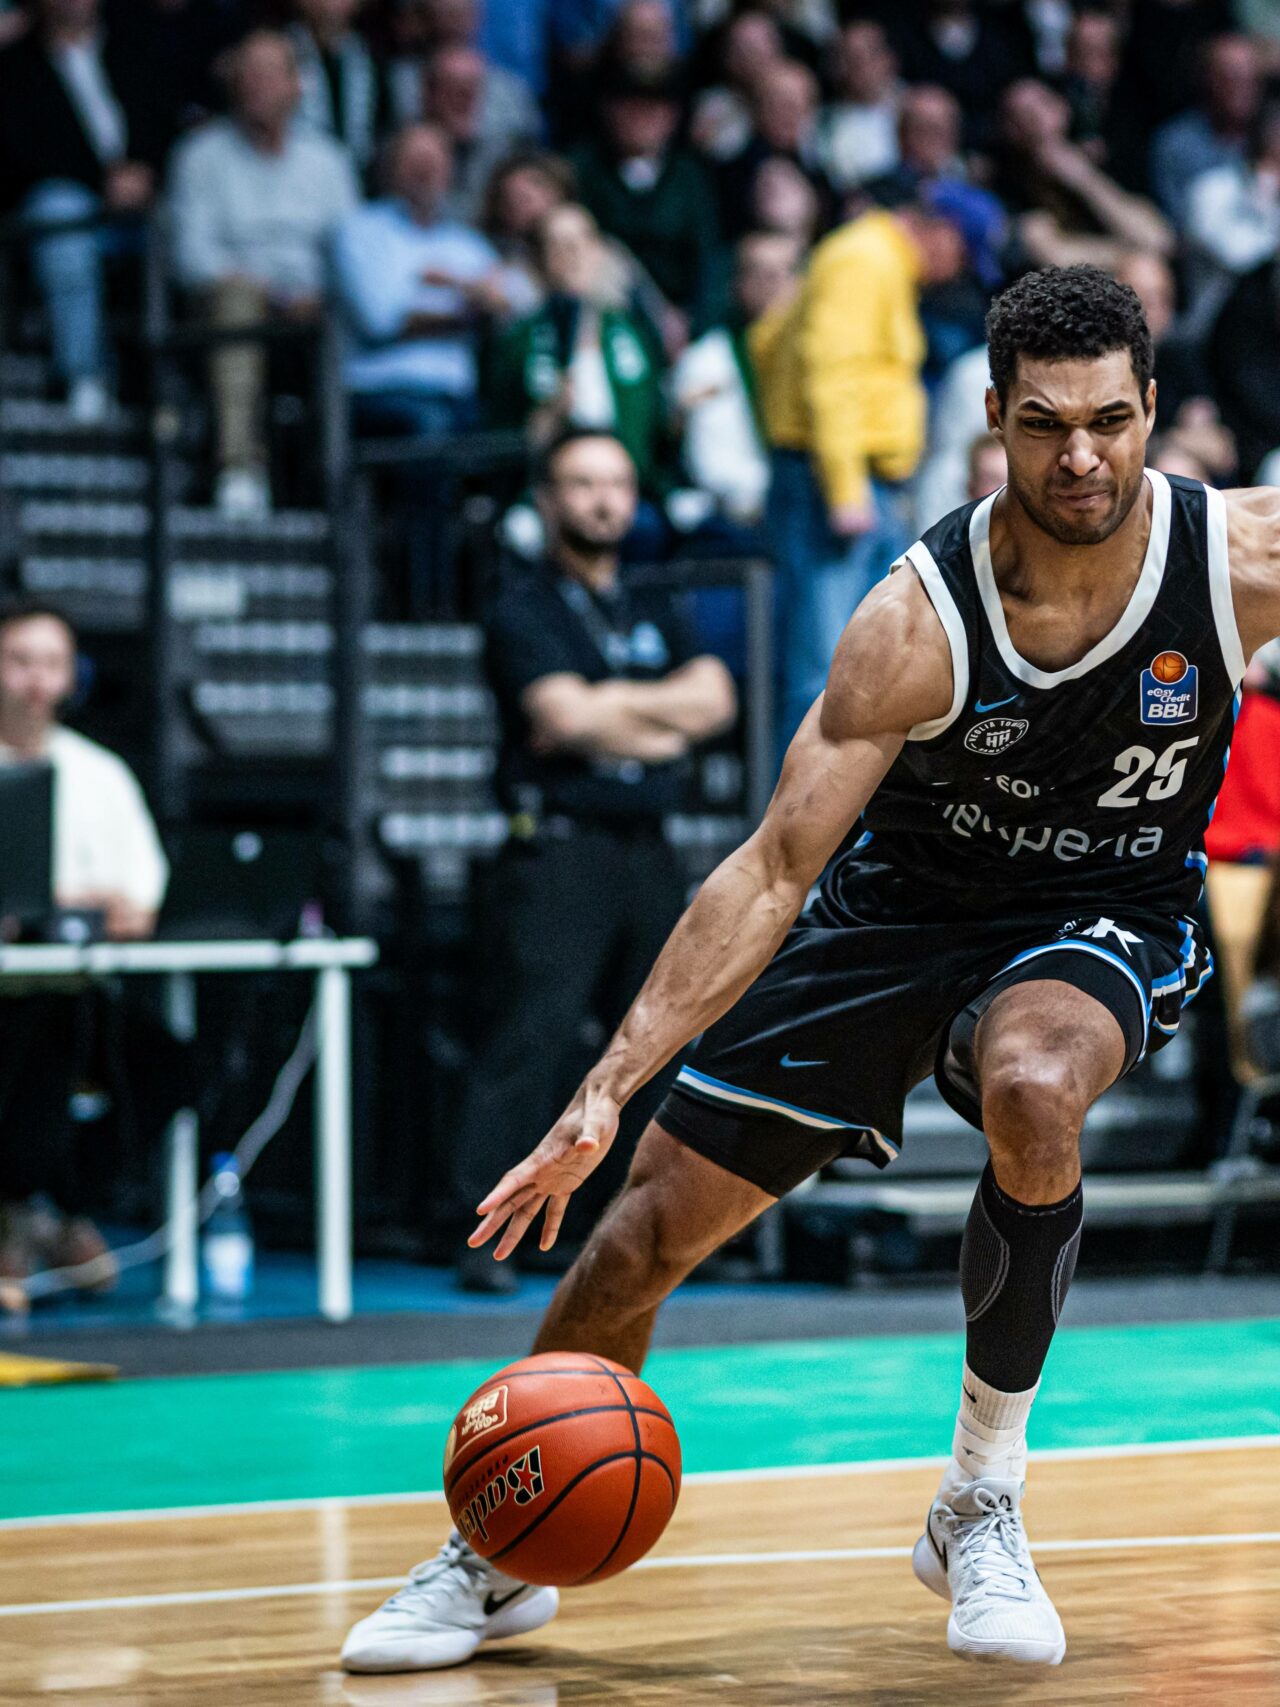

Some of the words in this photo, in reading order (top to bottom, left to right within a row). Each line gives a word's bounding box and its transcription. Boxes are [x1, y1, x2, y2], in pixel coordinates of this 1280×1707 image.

[1160, 693, 1191, 703] Credit
[1147, 702, 1190, 718] BBL
[968, 721, 996, 742] VEOLIA
[1097, 735, 1200, 808] 25
